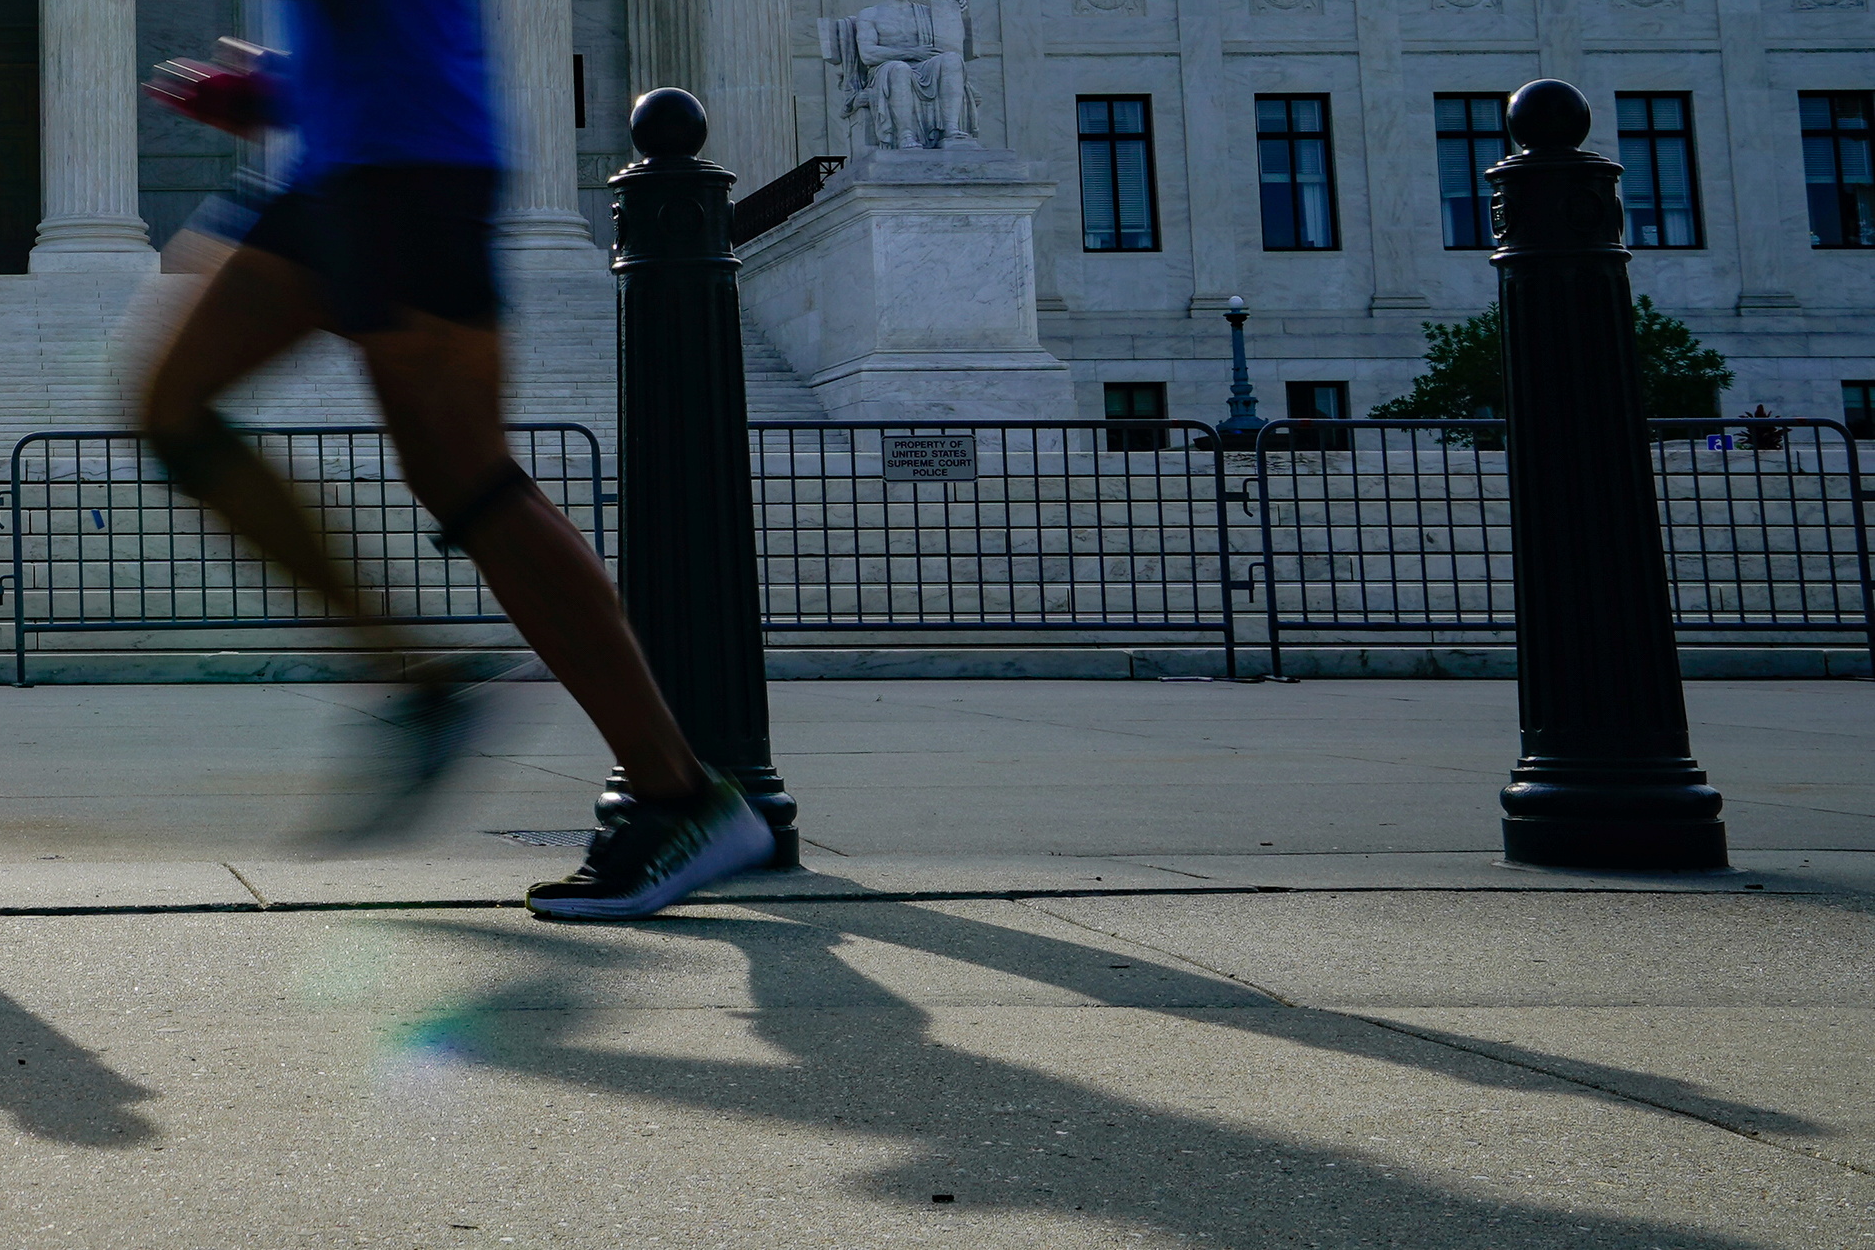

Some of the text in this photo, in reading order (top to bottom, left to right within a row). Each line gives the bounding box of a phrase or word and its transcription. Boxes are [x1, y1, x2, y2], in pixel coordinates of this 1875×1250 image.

[894, 440, 963, 449] PROPERTY OF
[892, 449, 967, 458] UNITED STATES
[887, 459, 972, 467] SUPREME COURT
